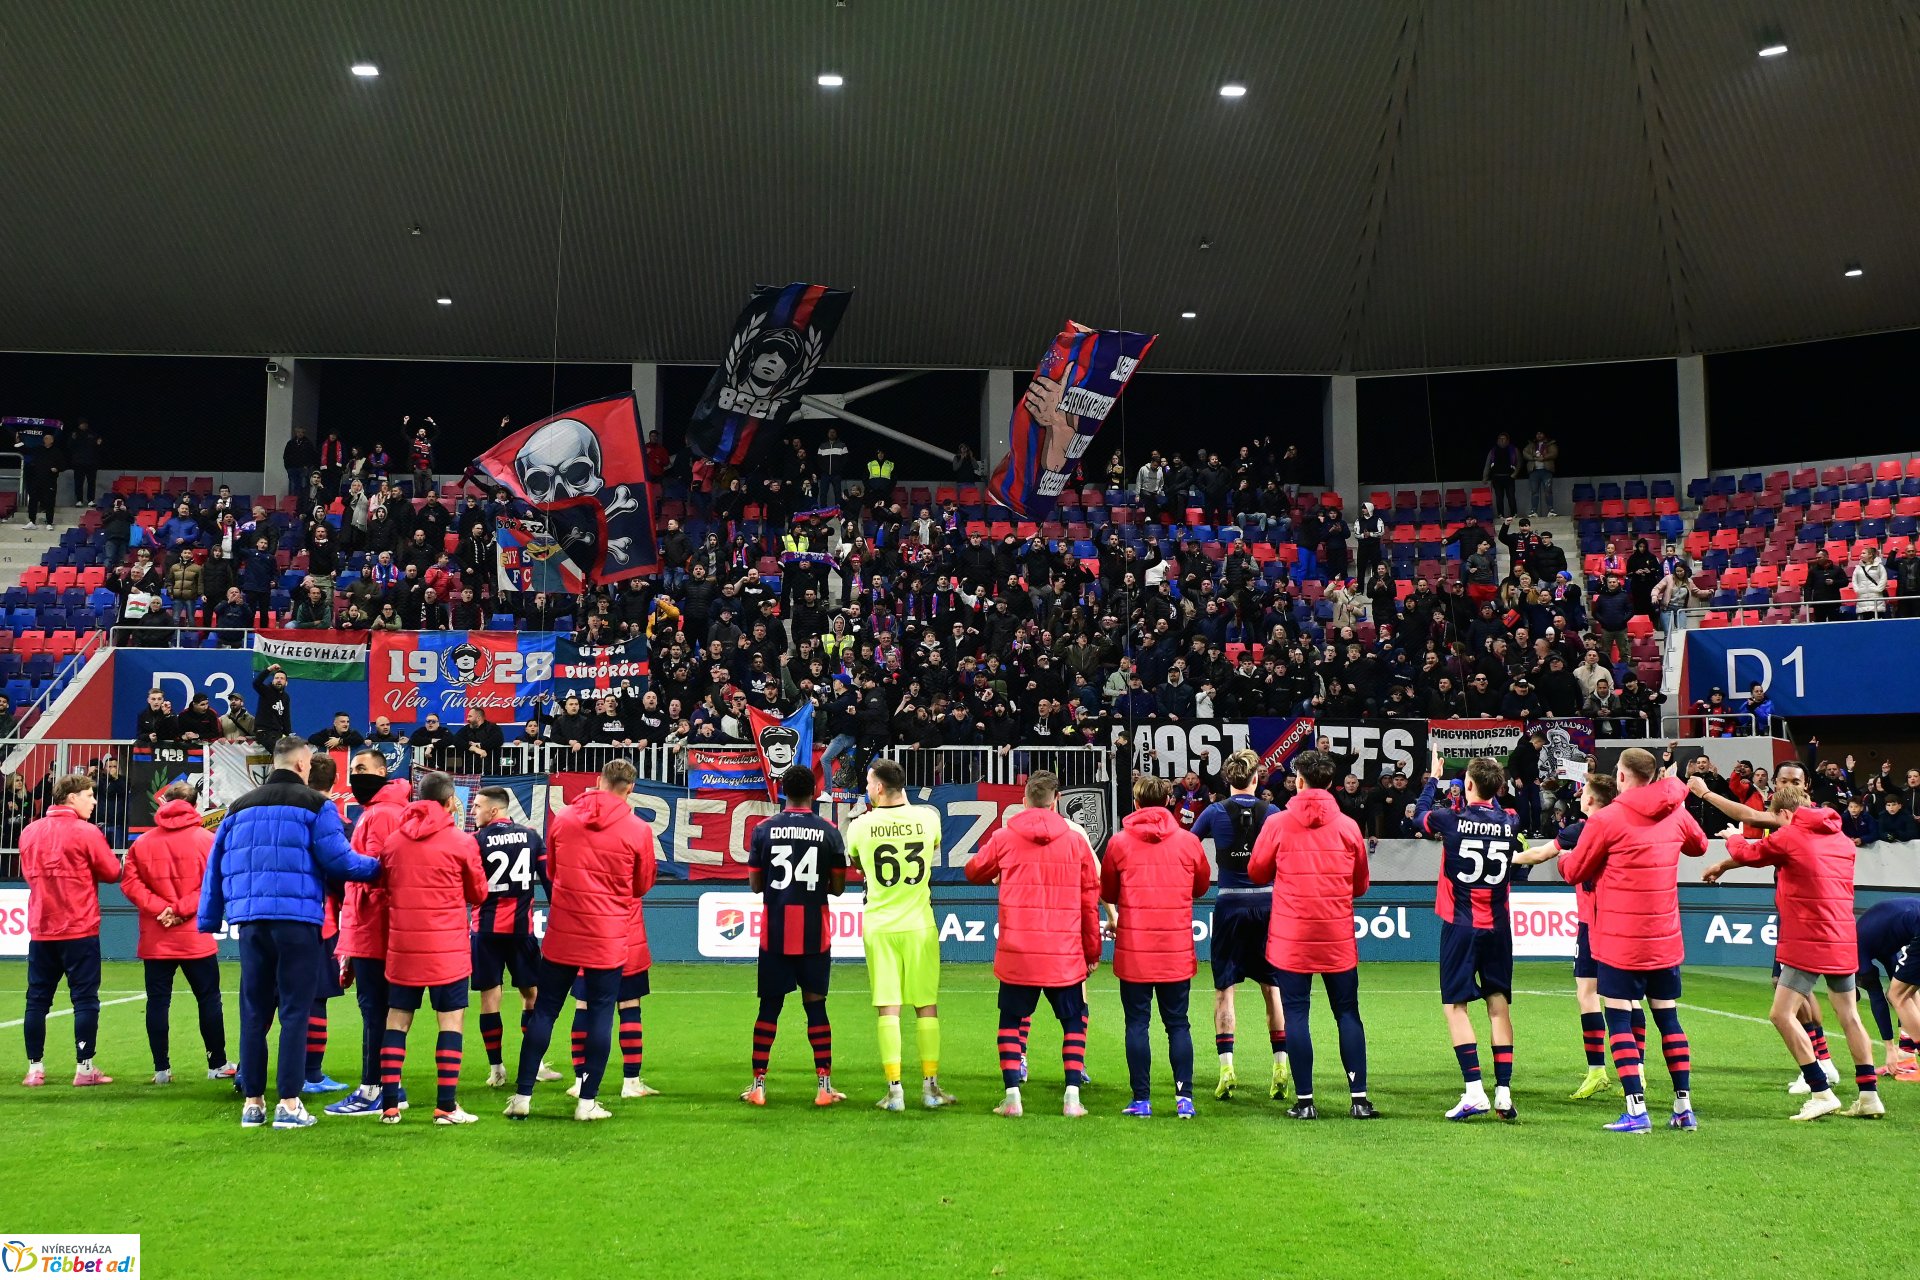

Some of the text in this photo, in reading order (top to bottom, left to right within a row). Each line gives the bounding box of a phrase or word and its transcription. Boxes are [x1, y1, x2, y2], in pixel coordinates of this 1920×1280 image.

[263, 641, 357, 660] NYÍREGYHÁZA
[565, 660, 640, 678] DÜBÖRÖG
[1726, 645, 1805, 700] D1
[152, 671, 235, 714] D3
[384, 686, 429, 711] Vén
[565, 688, 576, 699] A
[1431, 727, 1520, 740] MAGYARORSZÁG
[153, 748, 185, 762] 1928
[1142, 732, 1151, 773] 1995
[1443, 744, 1508, 758] PETNEHÁZA
[1083, 793, 1099, 840] NYSFC
[1457, 819, 1514, 837] KATONA B.
[486, 832, 528, 847] JOVANOV
[770, 827, 824, 842] EDOMWONYI
[870, 822, 926, 837] KOVÁCS D.
[486, 847, 532, 892] 24
[769, 845, 820, 891] 34
[873, 842, 925, 888] 63
[1456, 839, 1510, 885] 55
[938, 913, 986, 942] Az
[1704, 914, 1753, 945] Az
